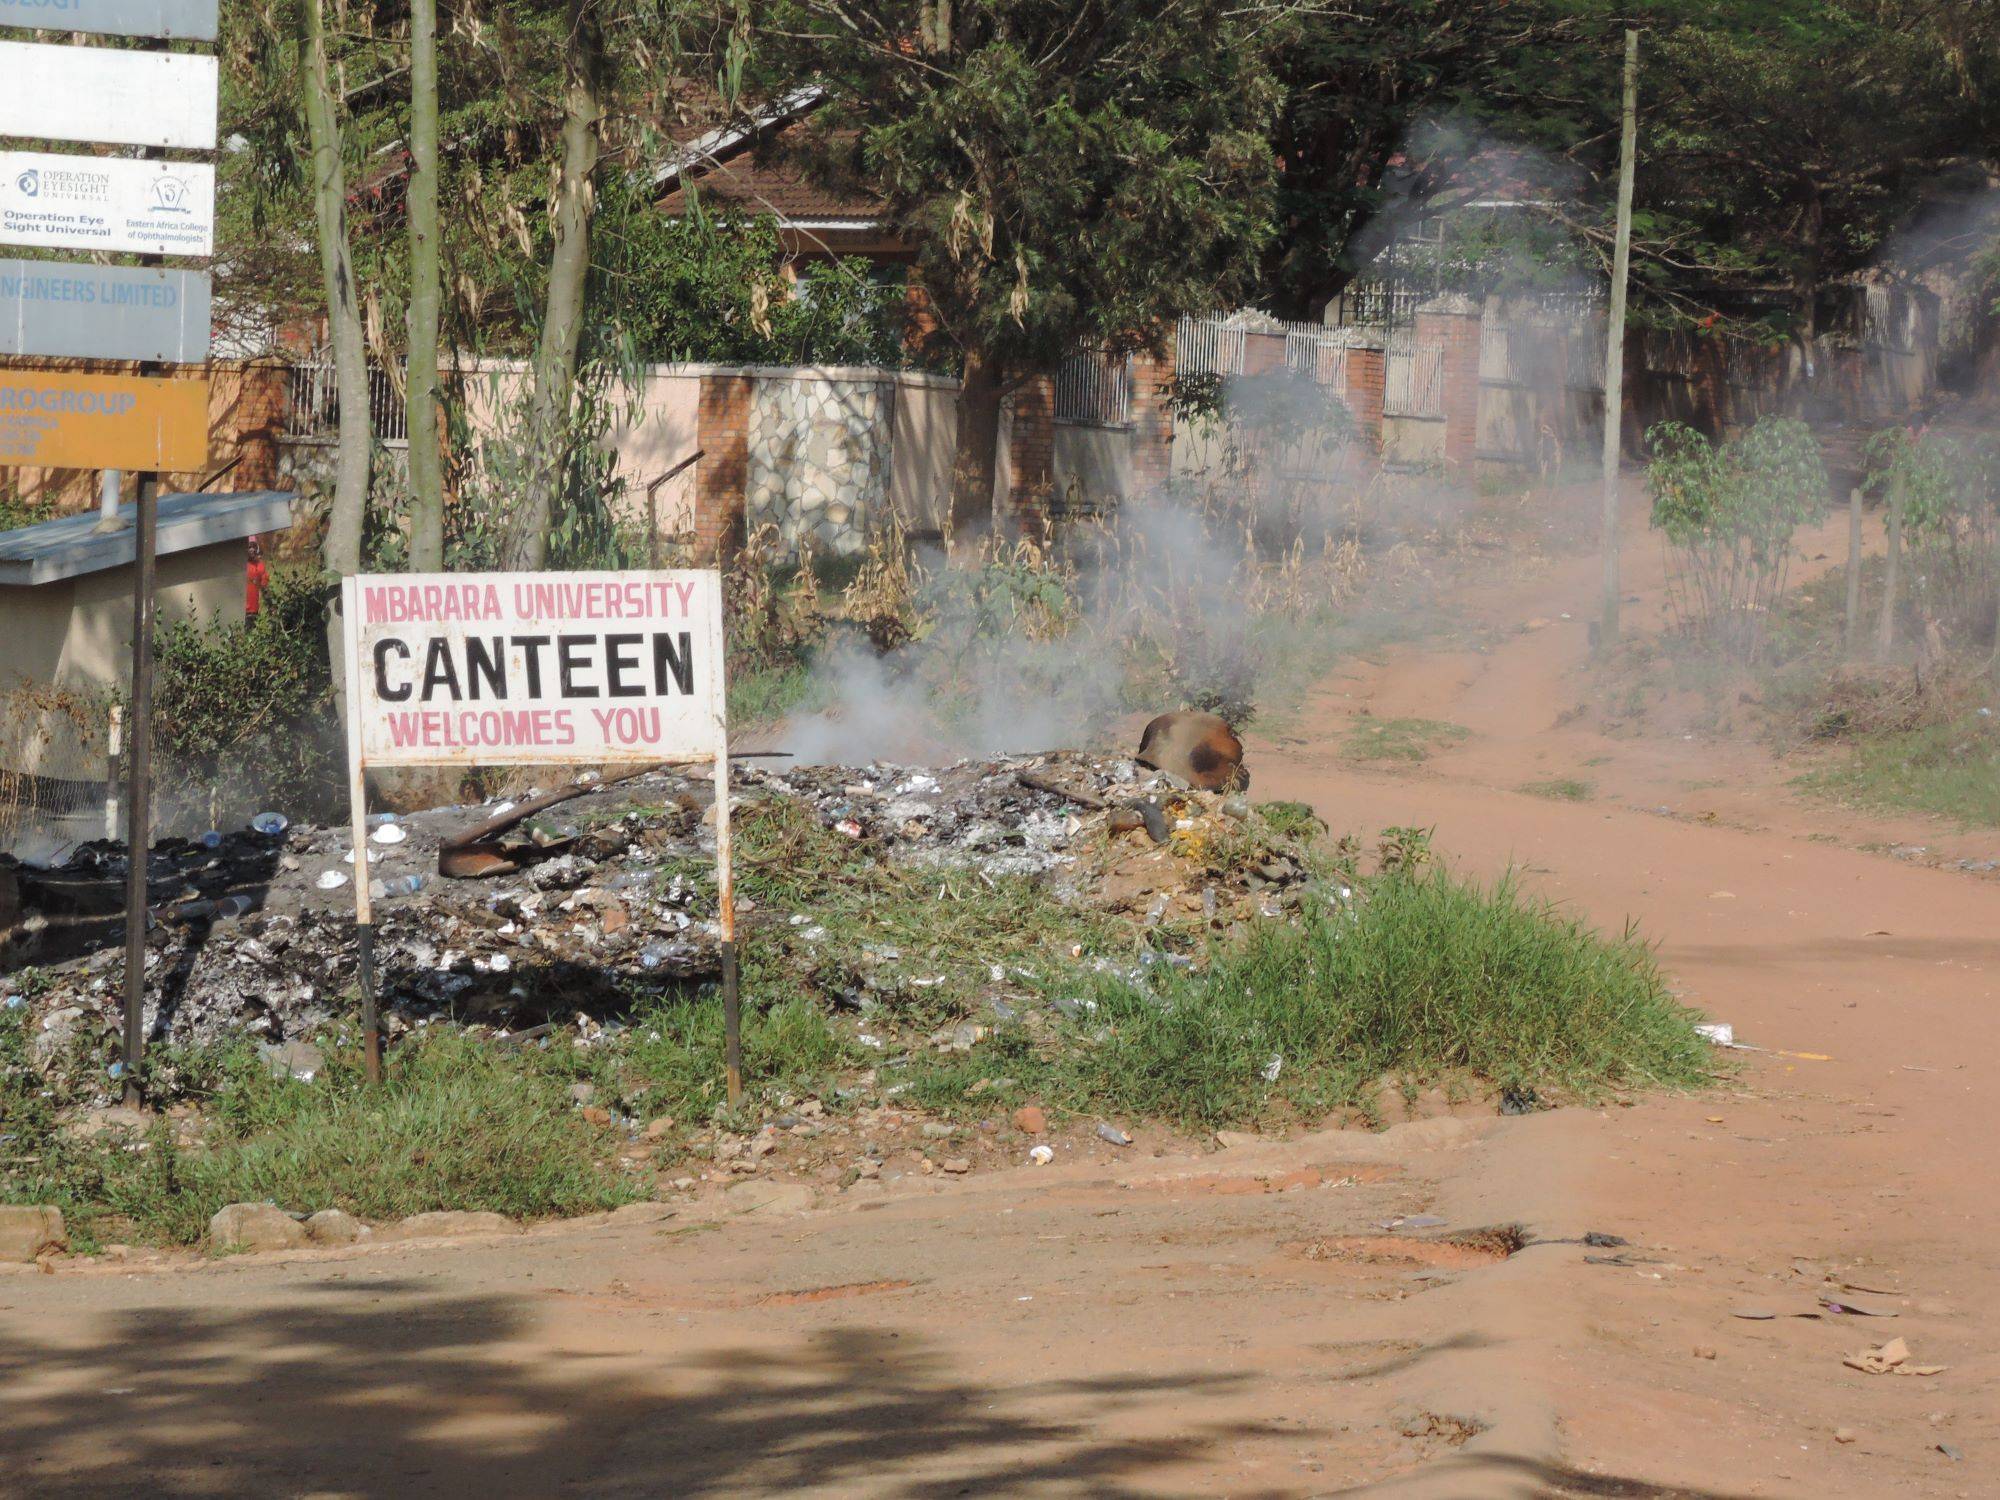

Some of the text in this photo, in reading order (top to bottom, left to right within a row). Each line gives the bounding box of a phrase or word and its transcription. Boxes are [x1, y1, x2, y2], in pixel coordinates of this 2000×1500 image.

[43, 170, 110, 184] OPERATION
[43, 181, 108, 194] EYESIGHT
[43, 191, 110, 201] UNIVERSAL
[4, 210, 104, 226] Operation Eye
[4, 221, 111, 236] Sight Universal
[126, 219, 208, 233] Eastern Africa College
[128, 231, 203, 243] of Ophthalmologists
[100, 281, 177, 308] LIMITED
[365, 582, 695, 623] MBARARA UNIVERSITY
[373, 631, 695, 702] CANTEEN
[388, 707, 661, 747] WELCOMES YOU
